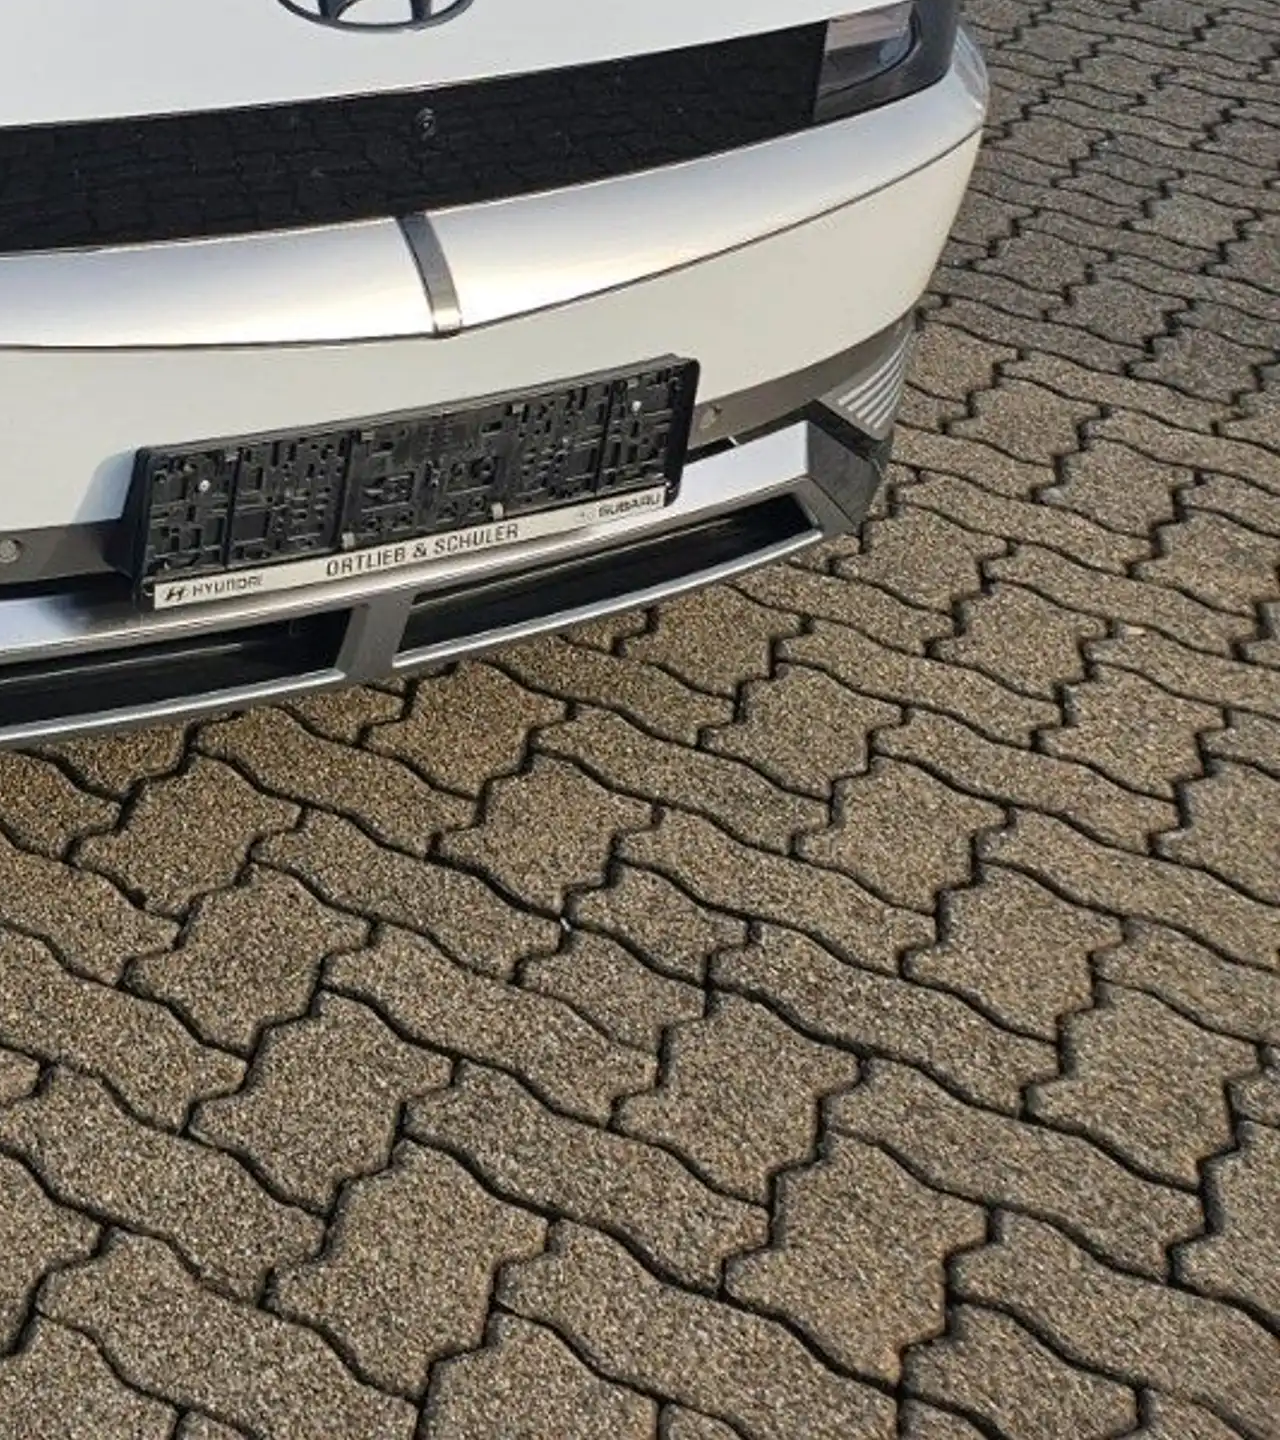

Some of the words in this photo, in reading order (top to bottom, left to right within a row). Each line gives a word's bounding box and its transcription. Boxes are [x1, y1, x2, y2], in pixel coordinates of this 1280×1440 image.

[192, 575, 262, 597] HYUNDAI
[326, 546, 405, 577] ORTLIEB
[413, 542, 427, 559] &
[433, 523, 519, 555] SCHULER
